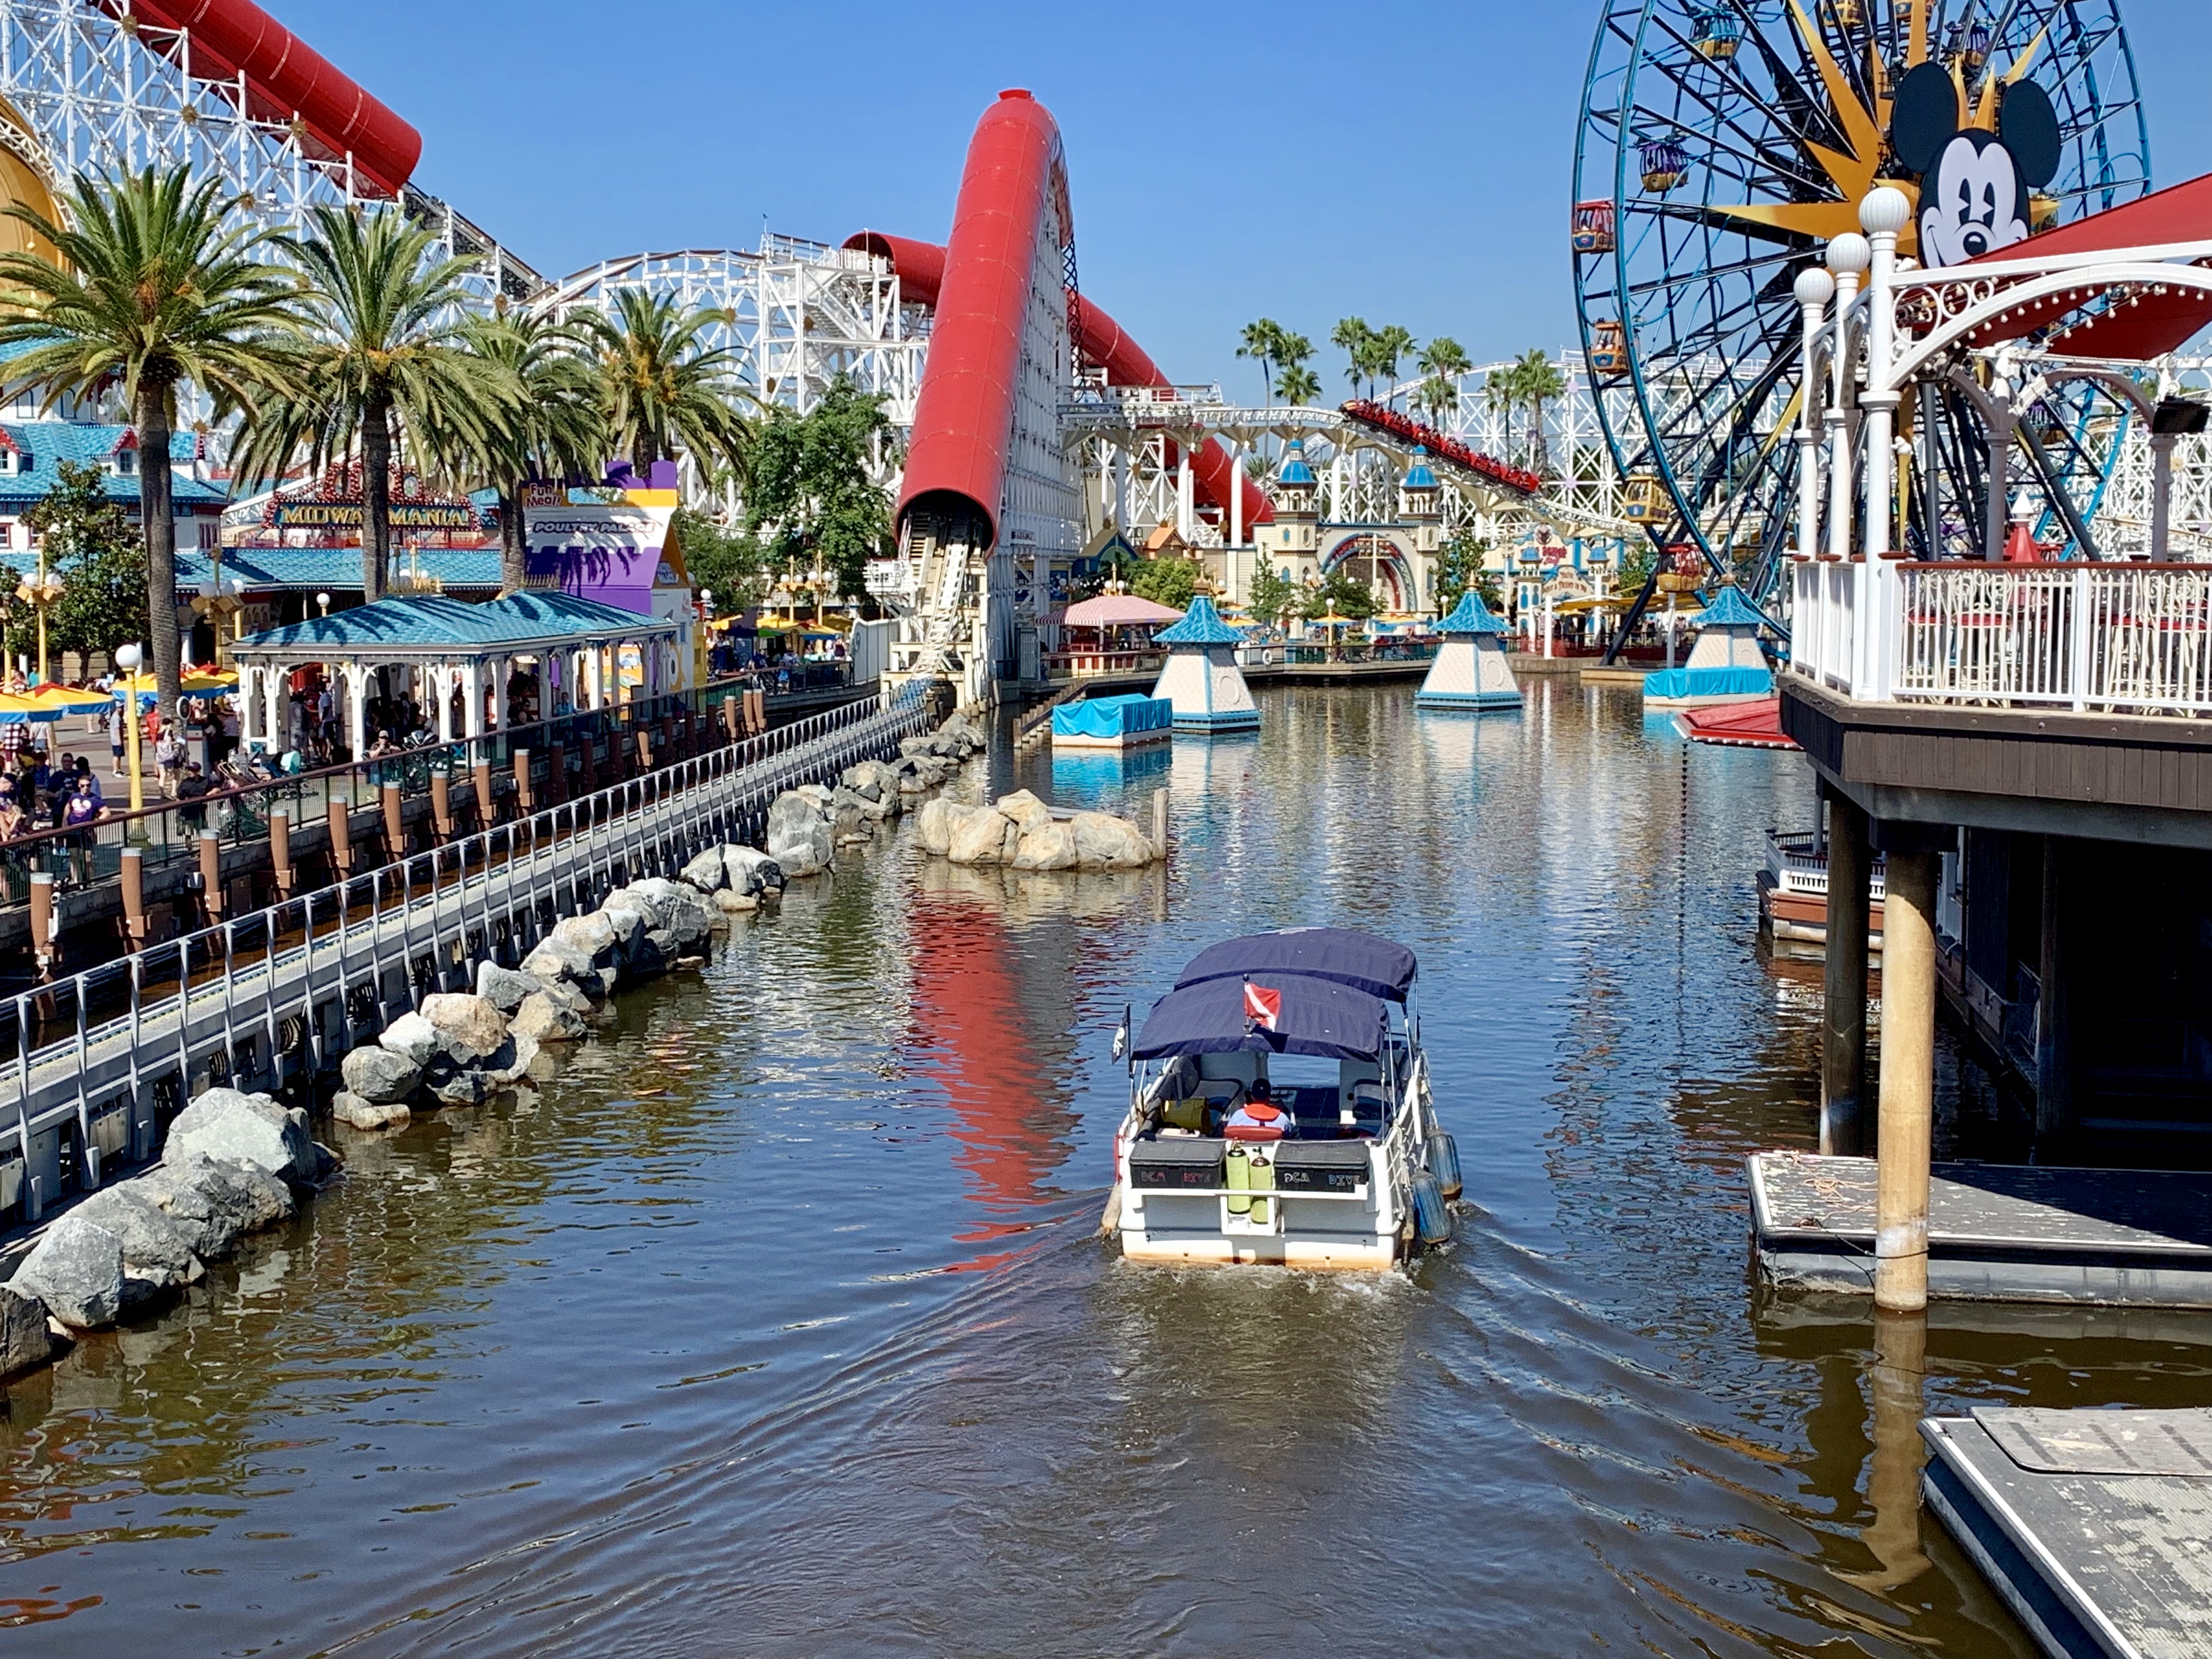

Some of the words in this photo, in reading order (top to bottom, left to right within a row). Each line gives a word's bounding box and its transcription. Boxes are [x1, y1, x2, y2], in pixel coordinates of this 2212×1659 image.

[531, 484, 552, 495] Fun
[527, 495, 561, 507] Meal!
[280, 505, 364, 524] MIDWA
[534, 521, 600, 533] POULTRY
[1284, 1172, 1310, 1183] DCA
[1328, 1174, 1361, 1186] DIVE
